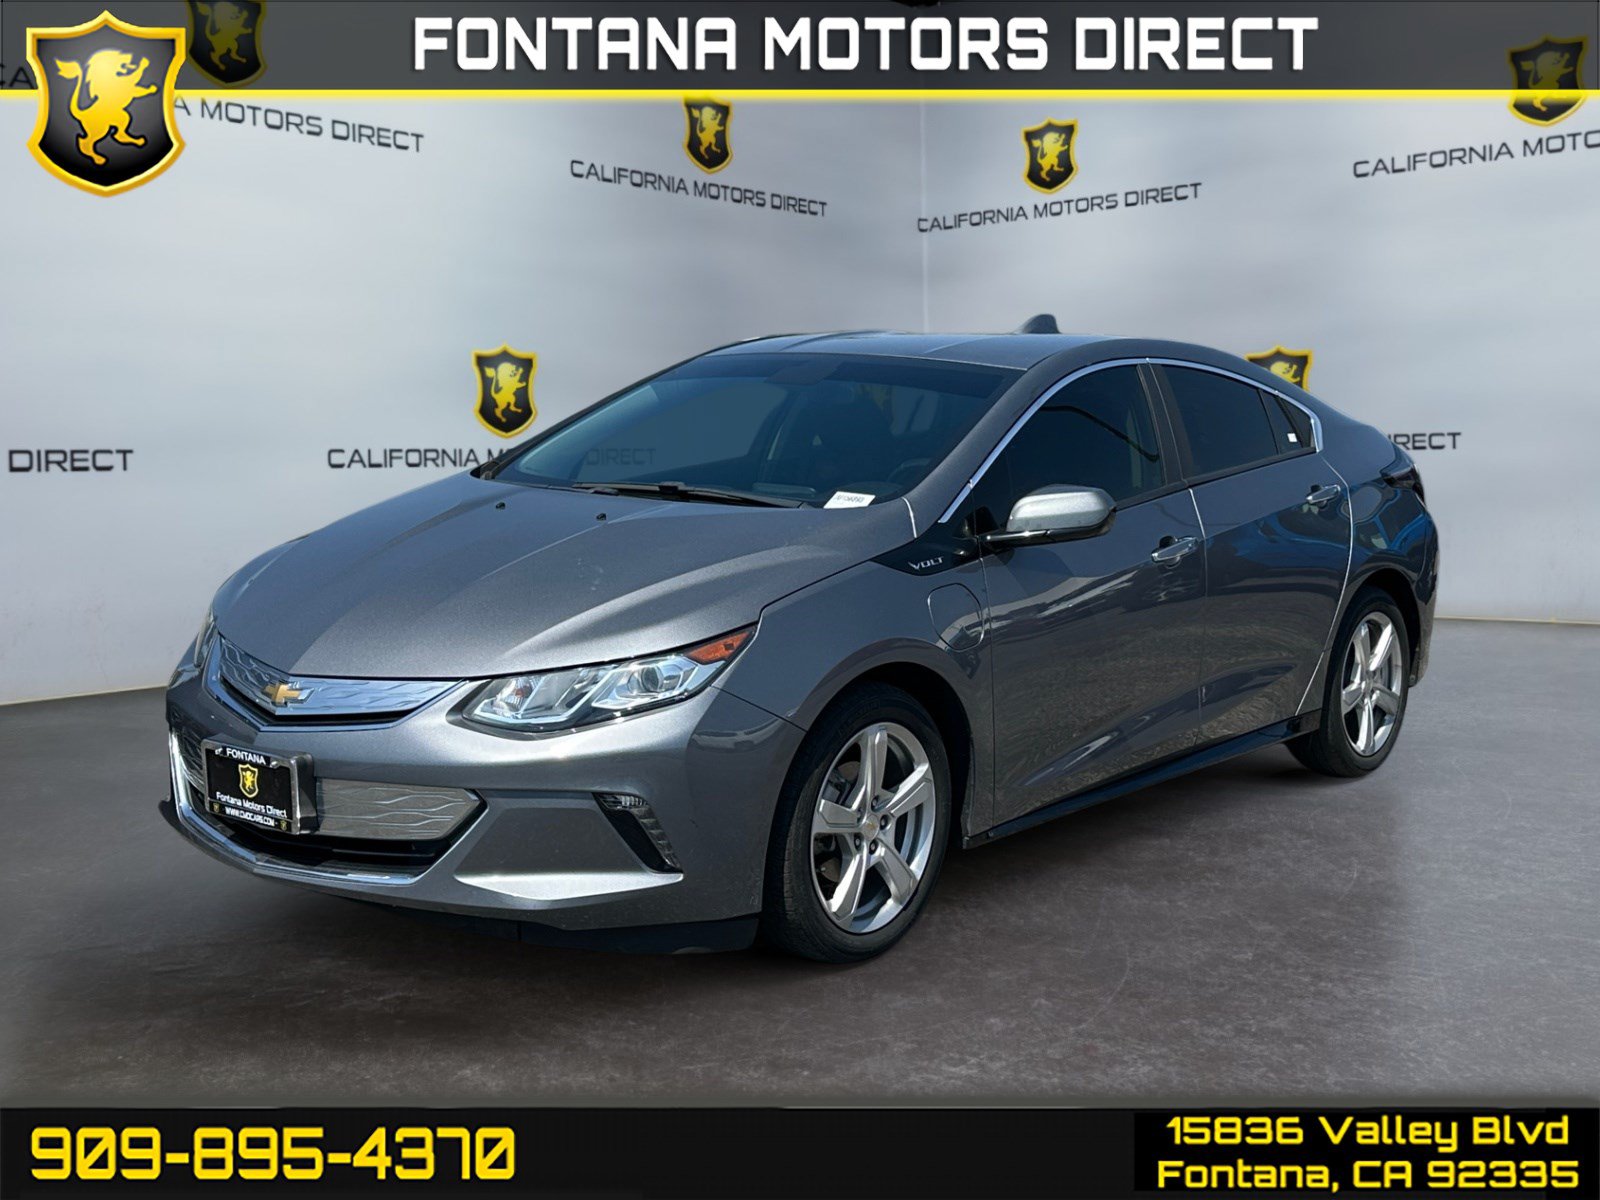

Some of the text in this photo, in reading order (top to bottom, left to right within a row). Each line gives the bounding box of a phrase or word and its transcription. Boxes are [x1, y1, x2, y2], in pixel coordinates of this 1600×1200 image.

[200, 98, 323, 136] MOTORS
[331, 119, 424, 153] DIRECT
[1353, 141, 1515, 178] CALIFORNIA
[570, 159, 827, 217] CALIFORNIA MOTORS DIRECT
[917, 182, 1203, 233] CALIFORNIA MOTORS DIRECT
[1387, 432, 1461, 450] RECT
[8, 449, 134, 473] DIRECT
[327, 448, 480, 469] CALIFORNIA
[908, 556, 944, 570] VOLT
[226, 747, 266, 765] FONTANA
[216, 791, 287, 818] Fontana Motors Direct
